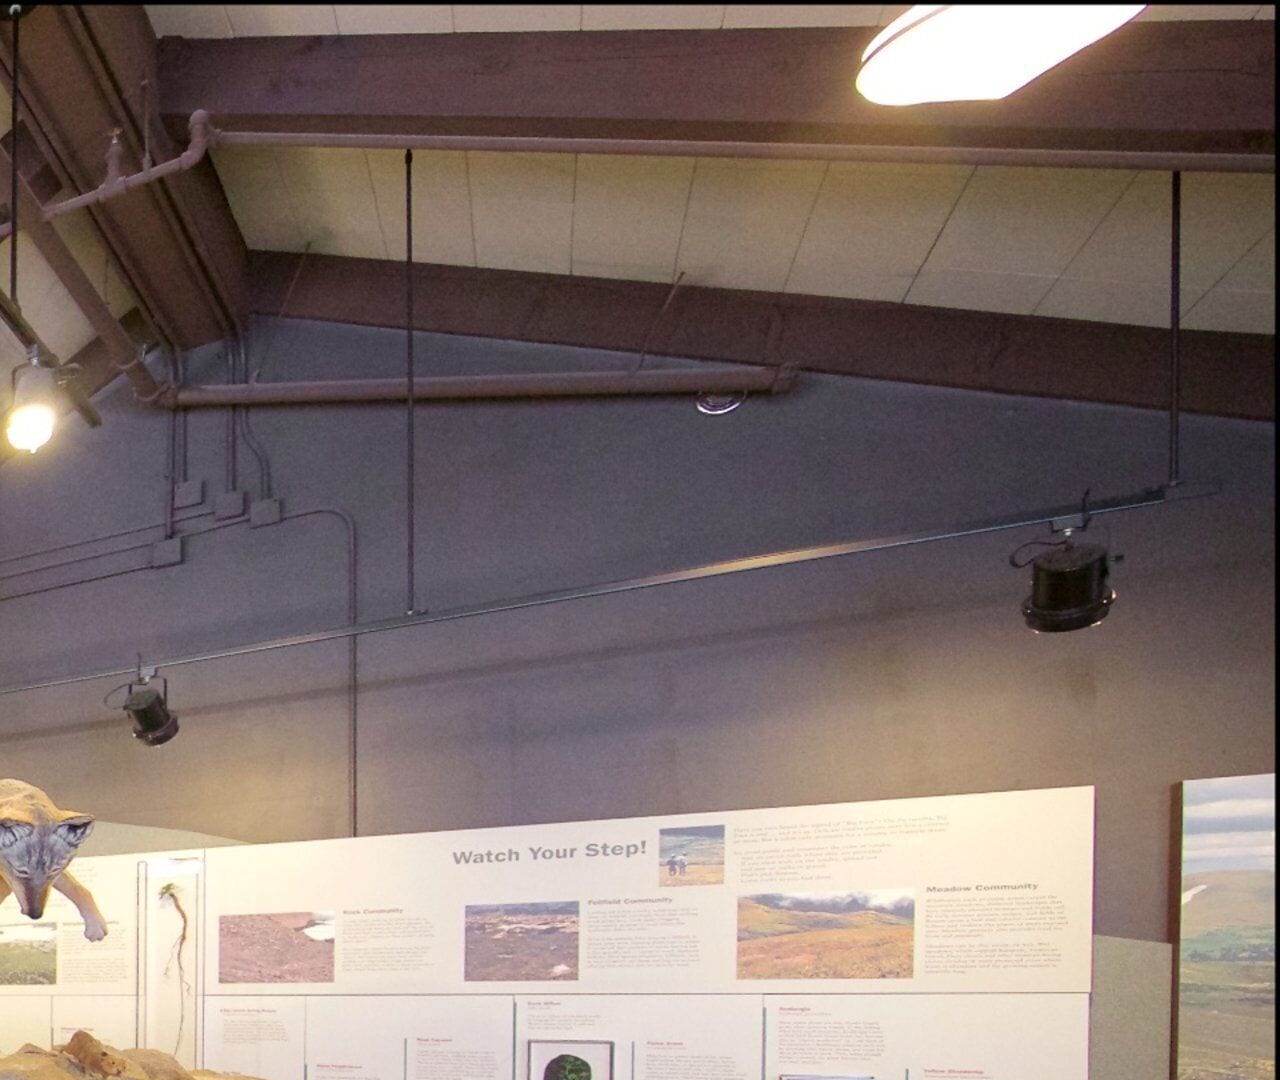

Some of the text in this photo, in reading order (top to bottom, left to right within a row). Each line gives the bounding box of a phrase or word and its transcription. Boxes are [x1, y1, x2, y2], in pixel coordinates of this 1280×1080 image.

[452, 840, 647, 866] Watch Your Step!
[926, 883, 1039, 893] Meadow Community
[623, 896, 673, 904] Community
